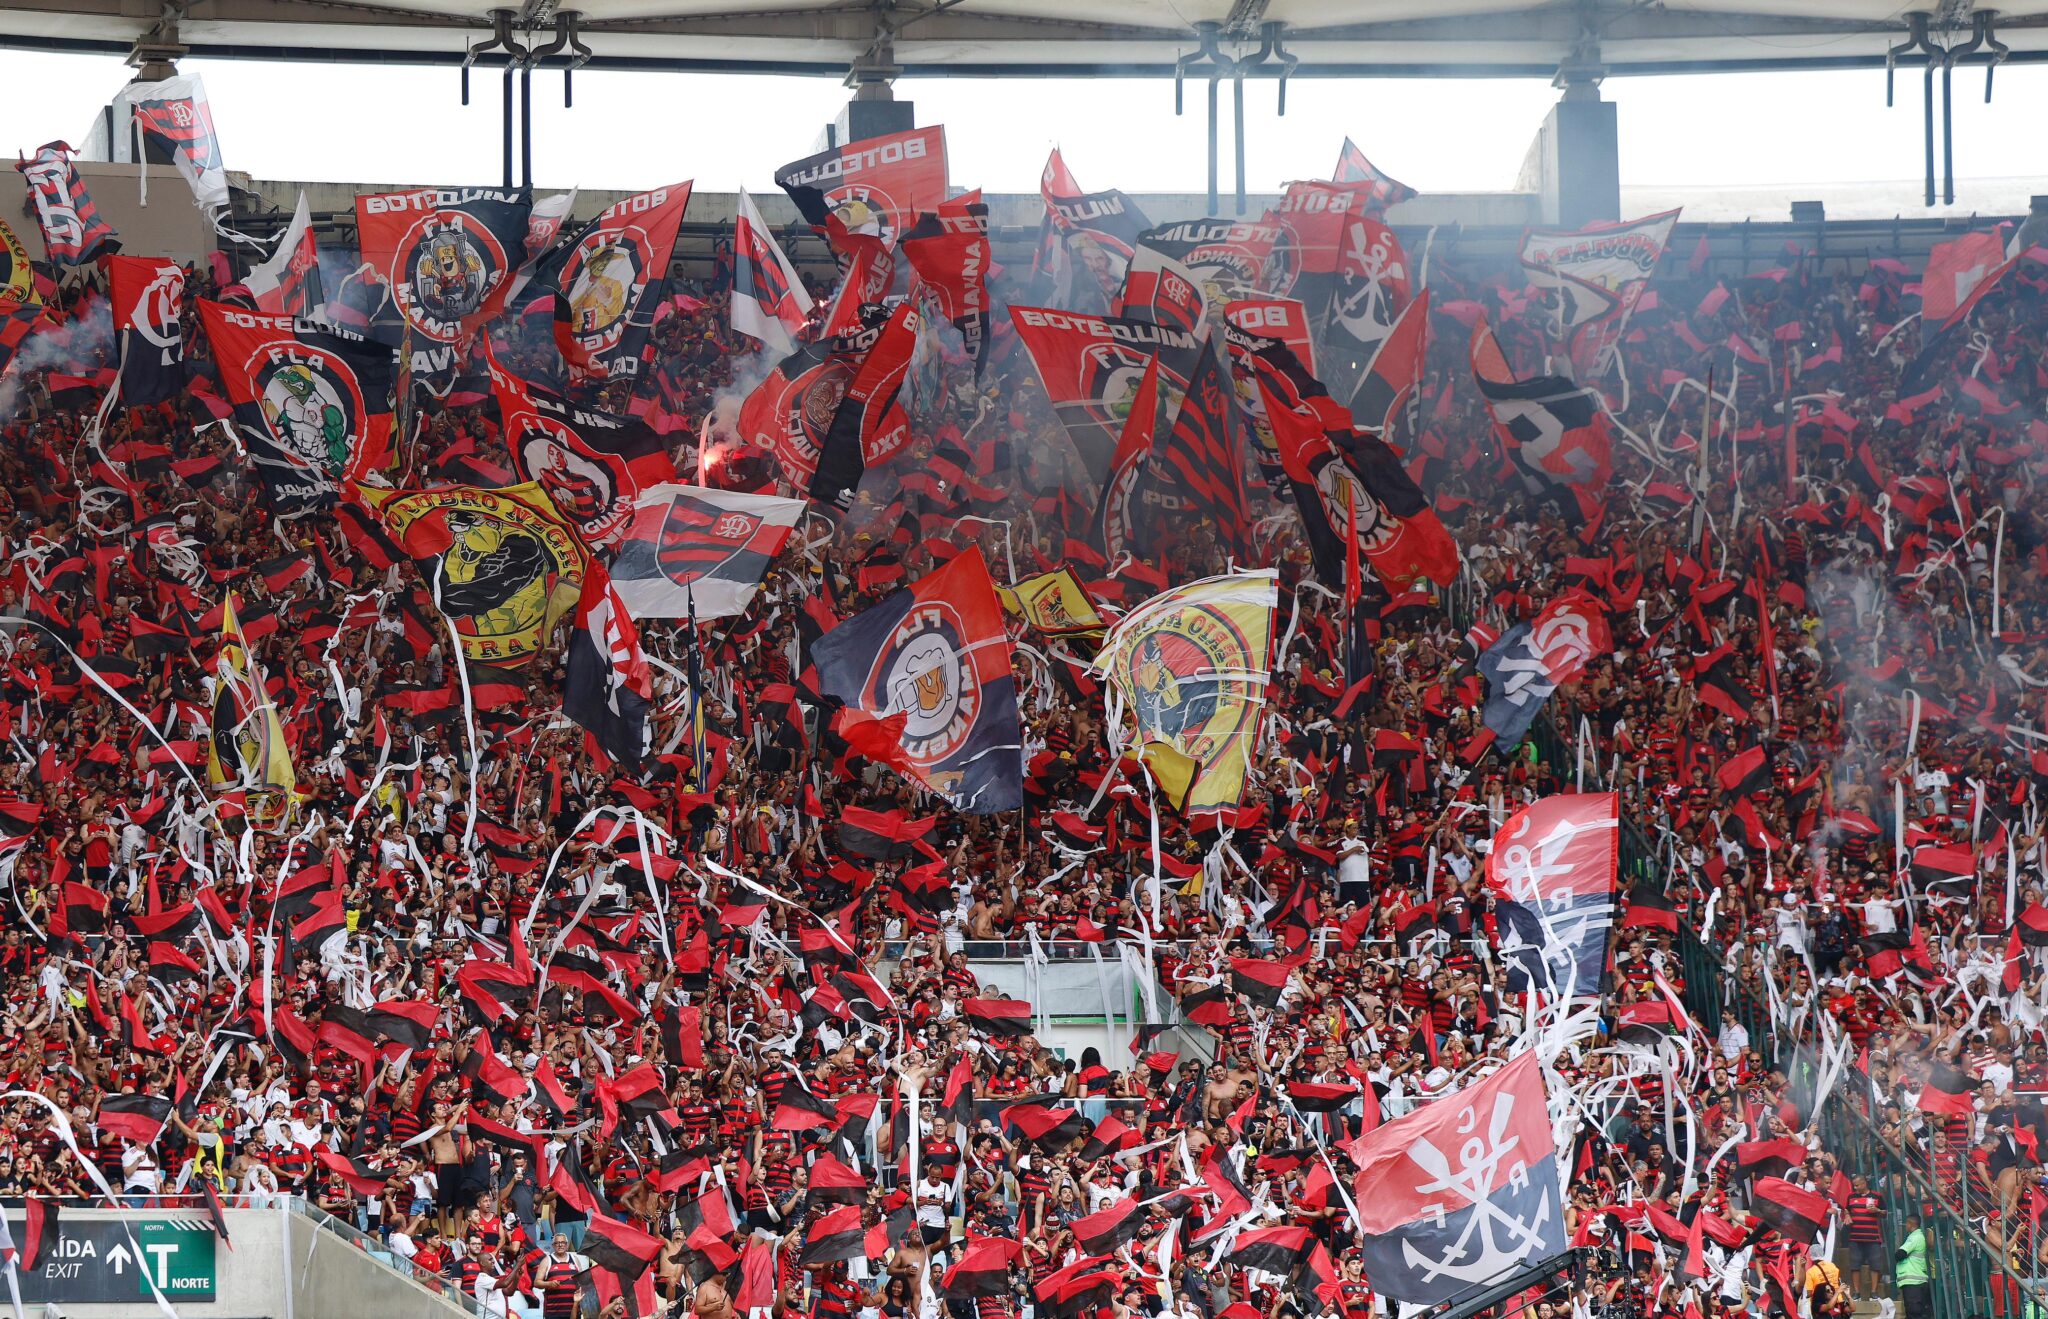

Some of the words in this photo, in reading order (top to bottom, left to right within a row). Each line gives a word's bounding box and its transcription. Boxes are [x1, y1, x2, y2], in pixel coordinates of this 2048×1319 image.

[366, 189, 520, 214] BOTEQUIM
[1056, 196, 1125, 221] QUIM
[423, 215, 463, 239] FLA
[221, 310, 364, 342] BOTEQUIM
[1019, 310, 1196, 350] BOTEQUIM
[267, 348, 325, 371] FLA
[521, 418, 571, 450] FLA
[51, 1235, 97, 1258] ÍDA
[45, 1263, 83, 1279] EXIT
[146, 1243, 179, 1288] T
[171, 1277, 210, 1289] NORTE
